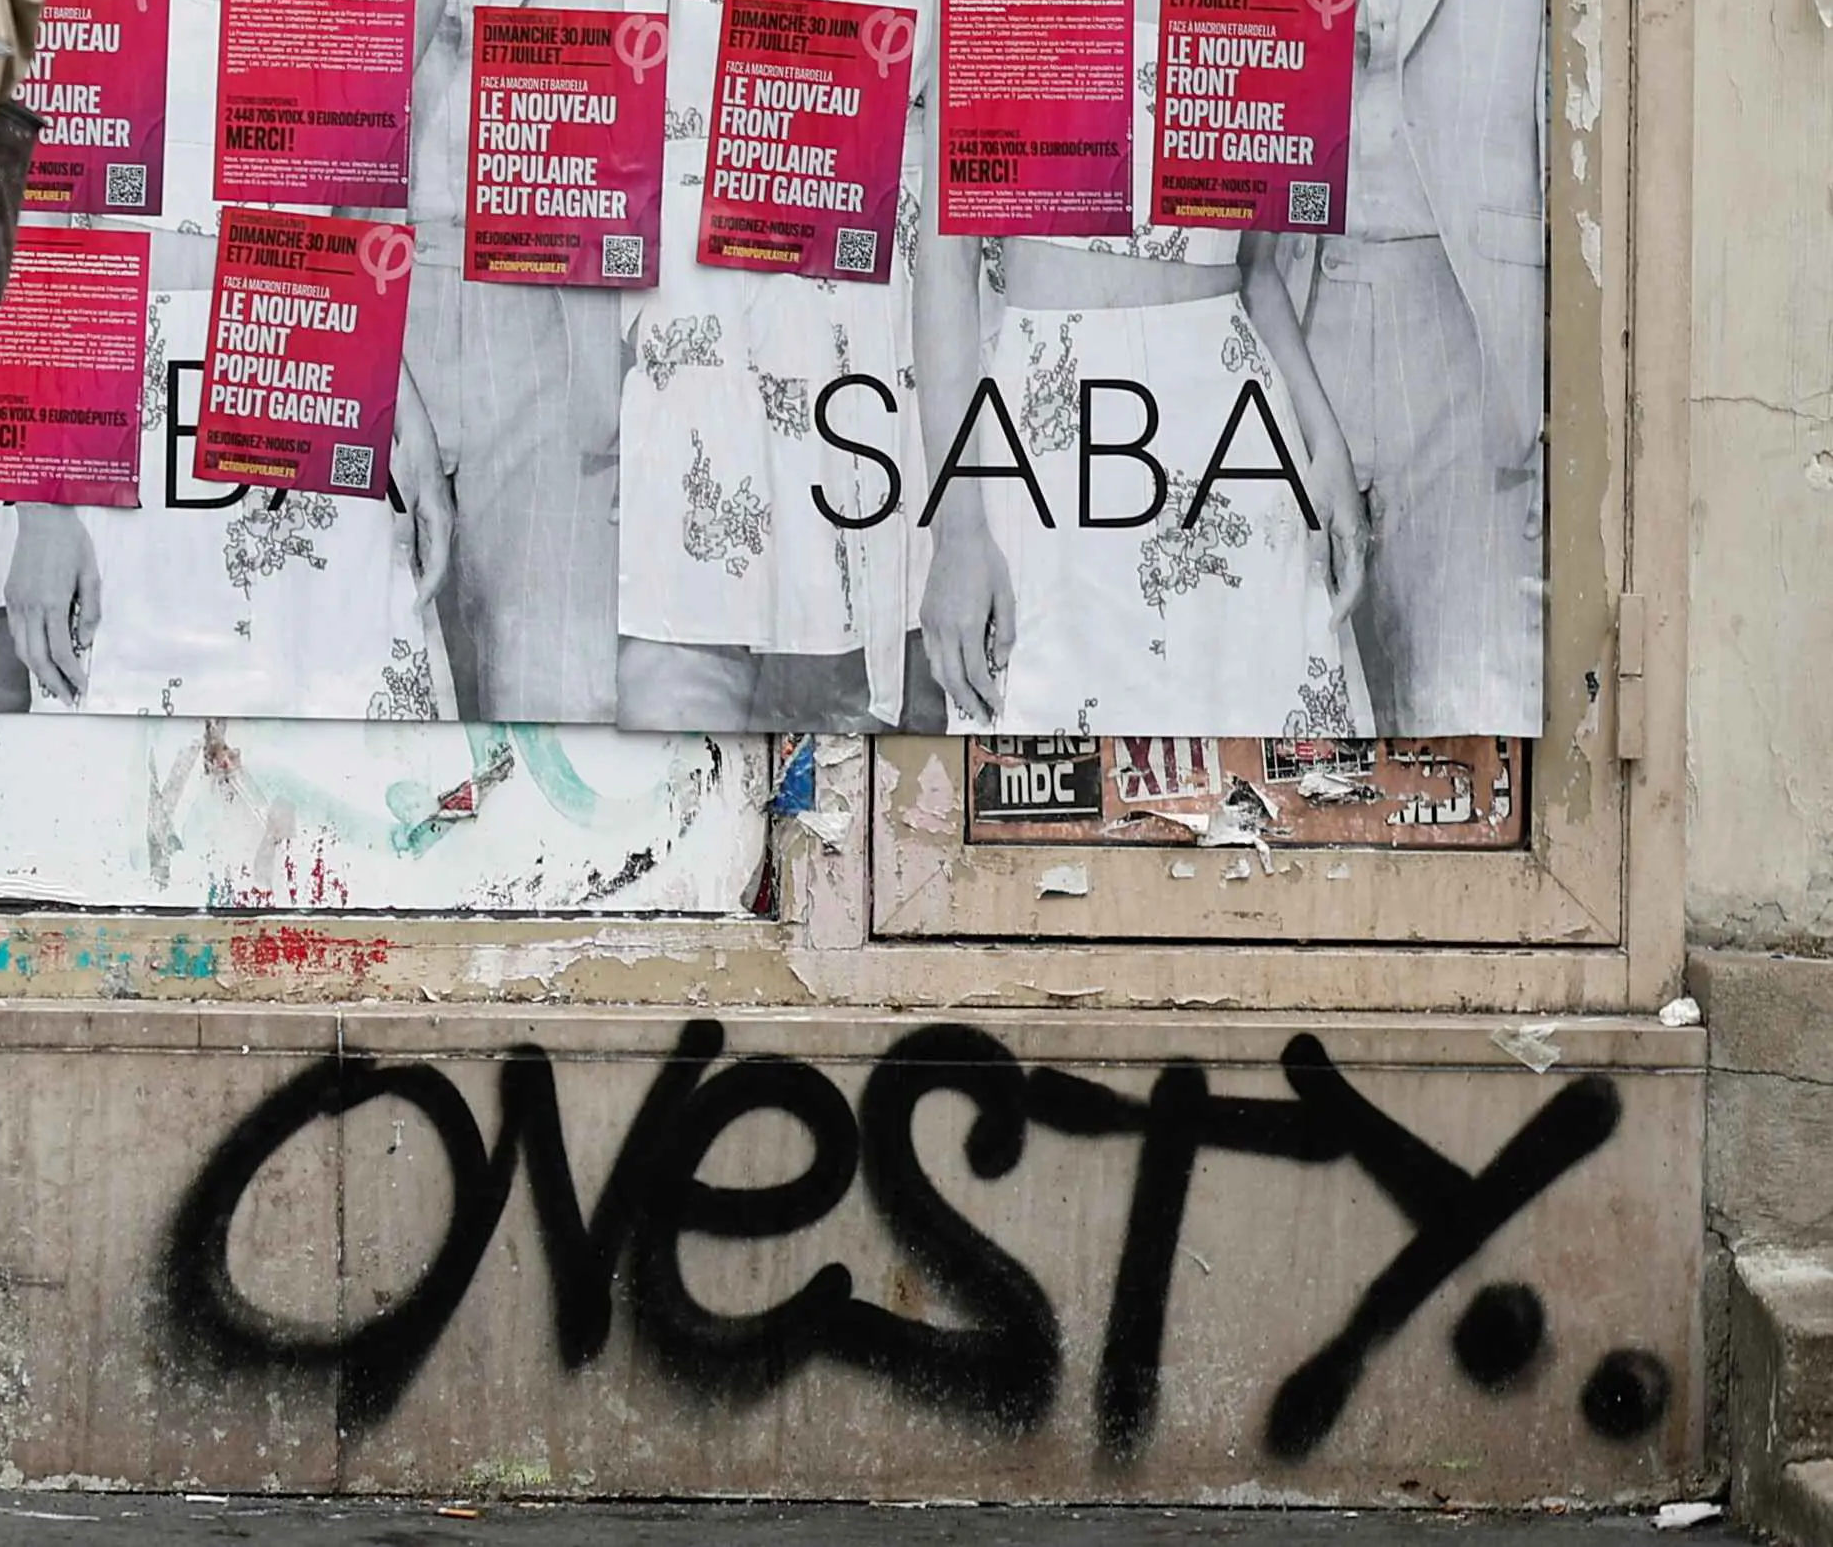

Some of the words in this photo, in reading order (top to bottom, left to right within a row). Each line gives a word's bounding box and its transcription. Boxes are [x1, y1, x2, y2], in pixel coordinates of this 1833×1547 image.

[1167, 36, 1193, 65] LE
[1199, 37, 1305, 70] NOUVEAU
[1166, 67, 1239, 97] FRONT
[1165, 97, 1285, 131] POPULAIRE
[1163, 130, 1219, 160] PEUT
[1222, 133, 1313, 165] GAGNER
[812, 373, 1321, 530] SABA
